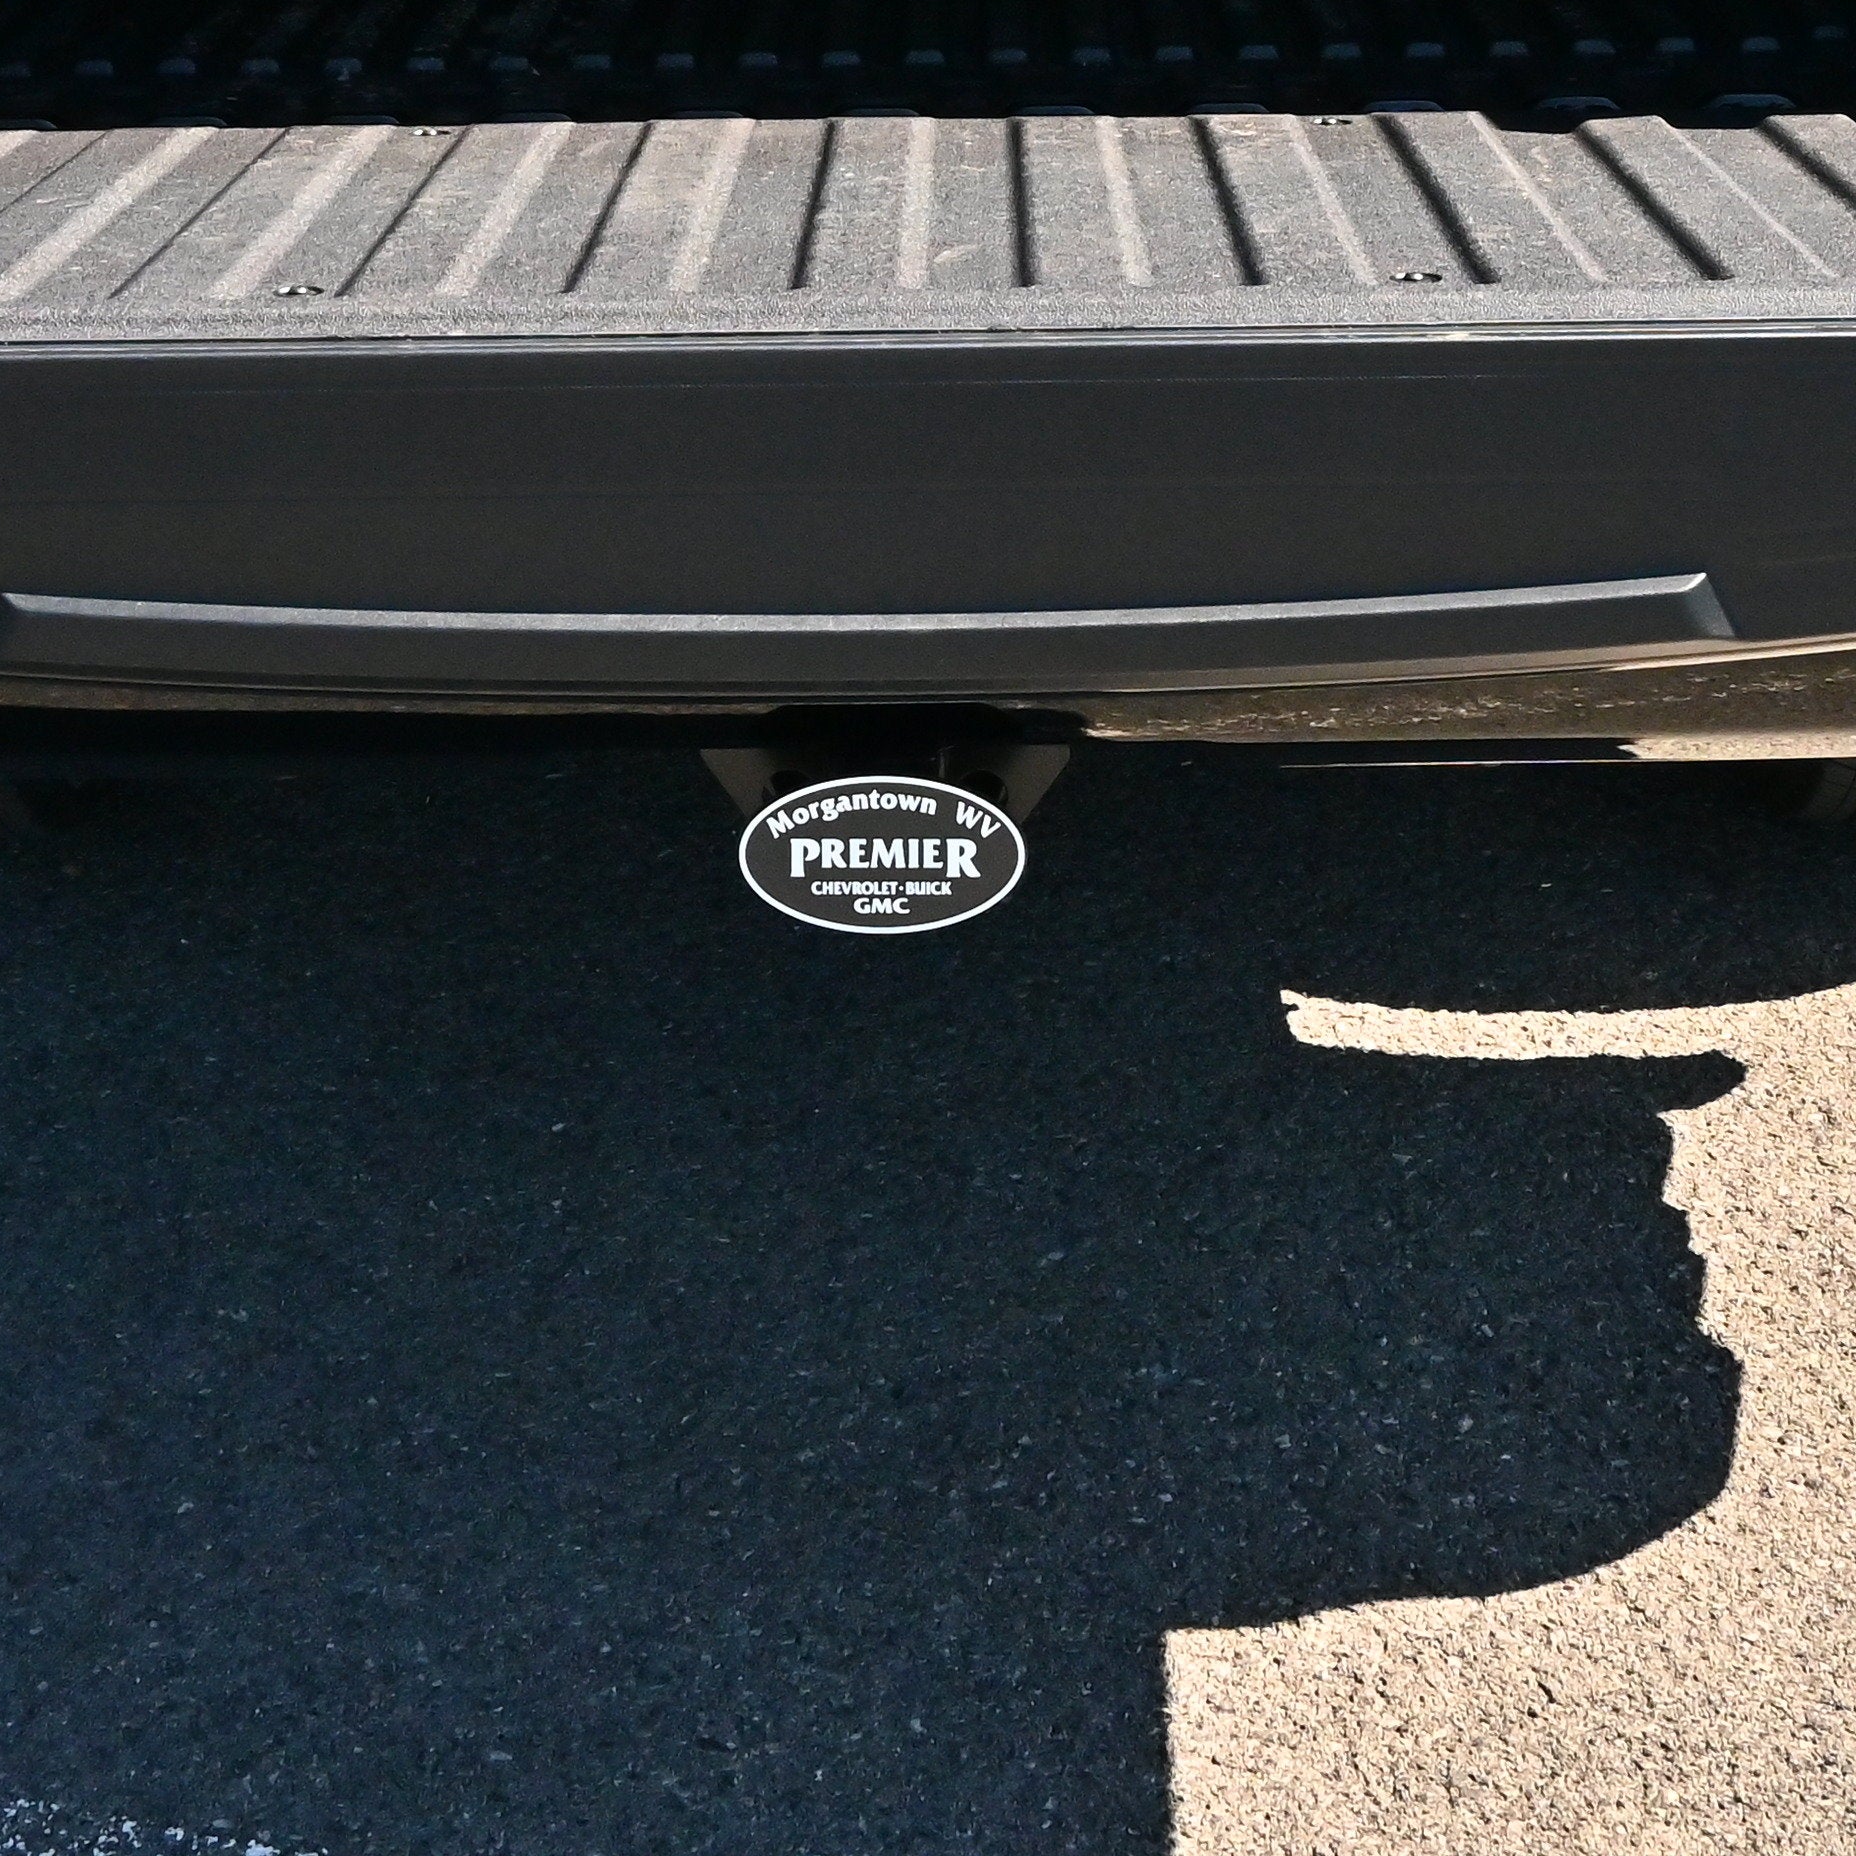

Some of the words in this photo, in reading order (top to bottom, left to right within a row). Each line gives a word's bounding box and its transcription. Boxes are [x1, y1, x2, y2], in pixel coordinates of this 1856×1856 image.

[765, 789, 938, 840] Morgantown
[955, 801, 1002, 840] WV
[790, 838, 981, 878] PREMIER
[853, 897, 911, 915] GMC
